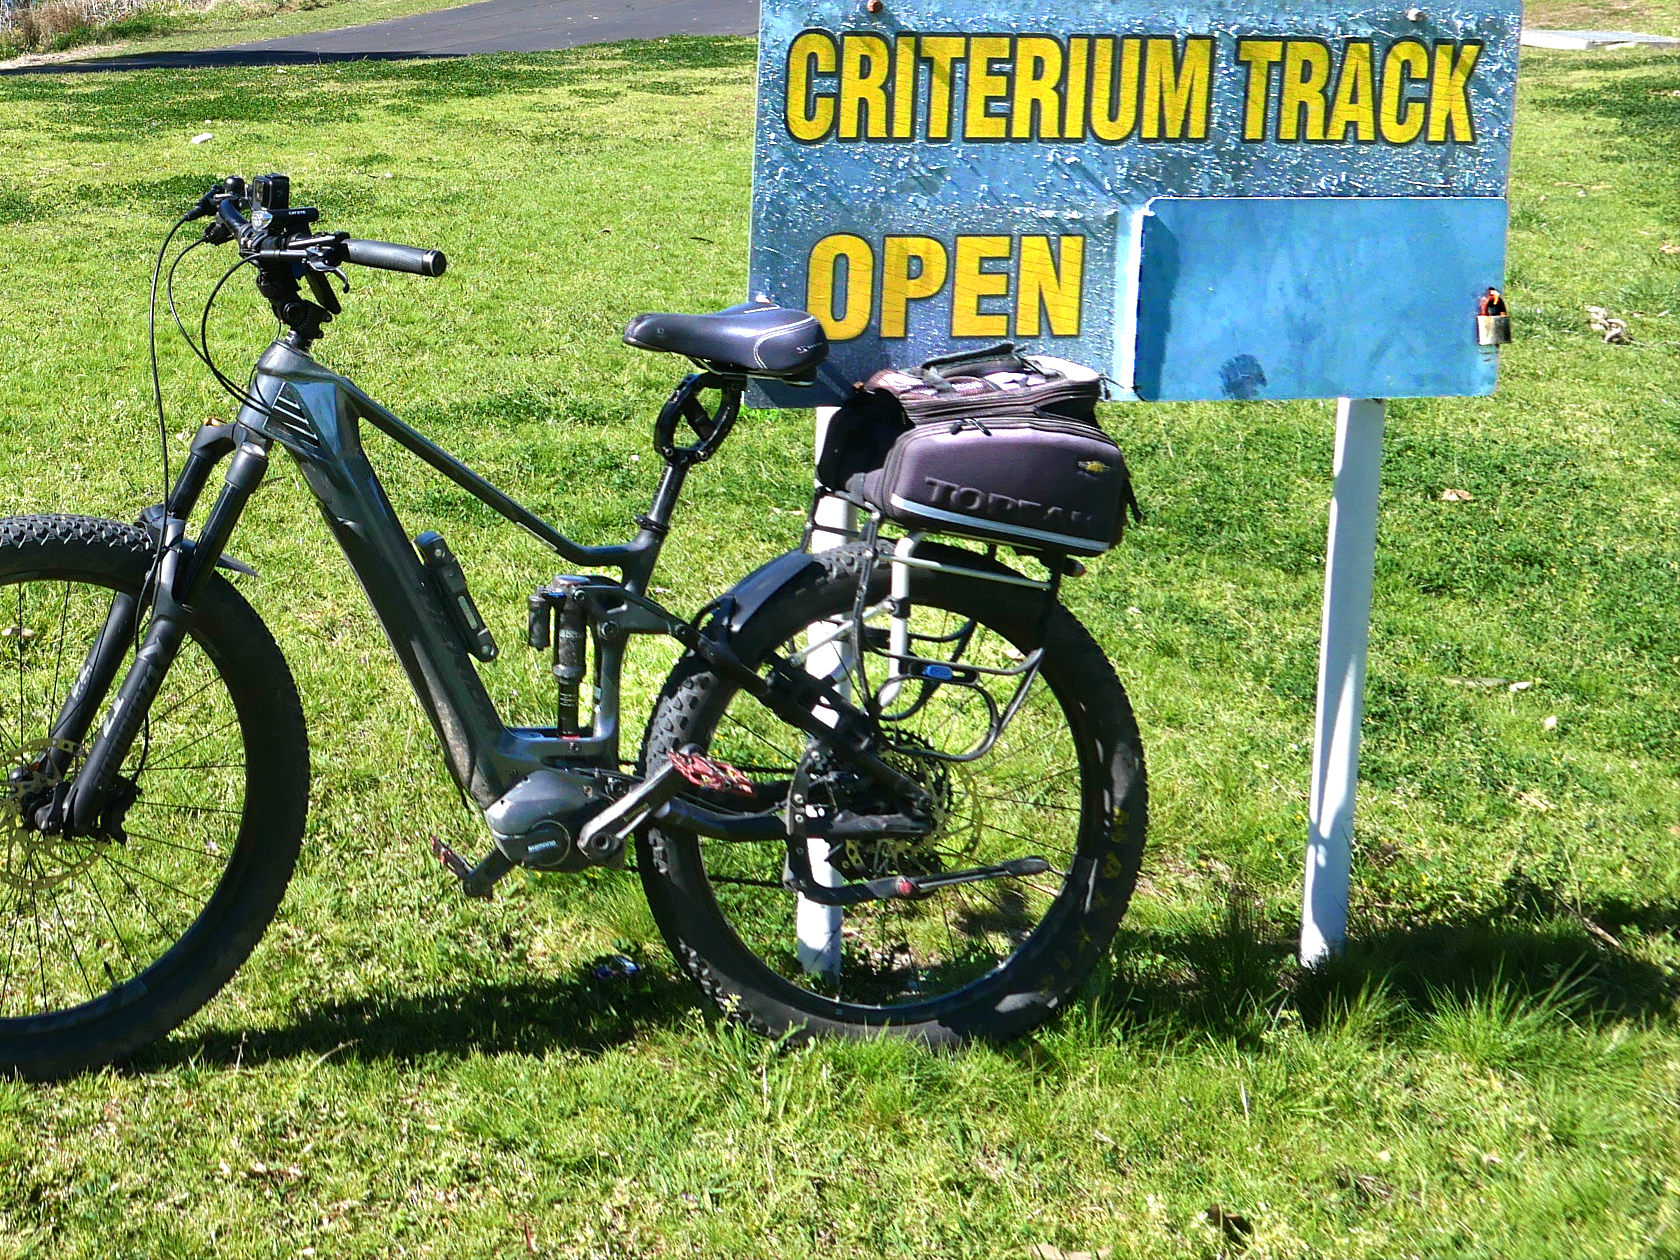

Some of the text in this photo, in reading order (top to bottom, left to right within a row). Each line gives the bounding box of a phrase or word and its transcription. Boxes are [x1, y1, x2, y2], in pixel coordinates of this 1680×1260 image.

[785, 28, 1484, 145] CRITERIUM TRACK
[806, 232, 1085, 341] OPEN
